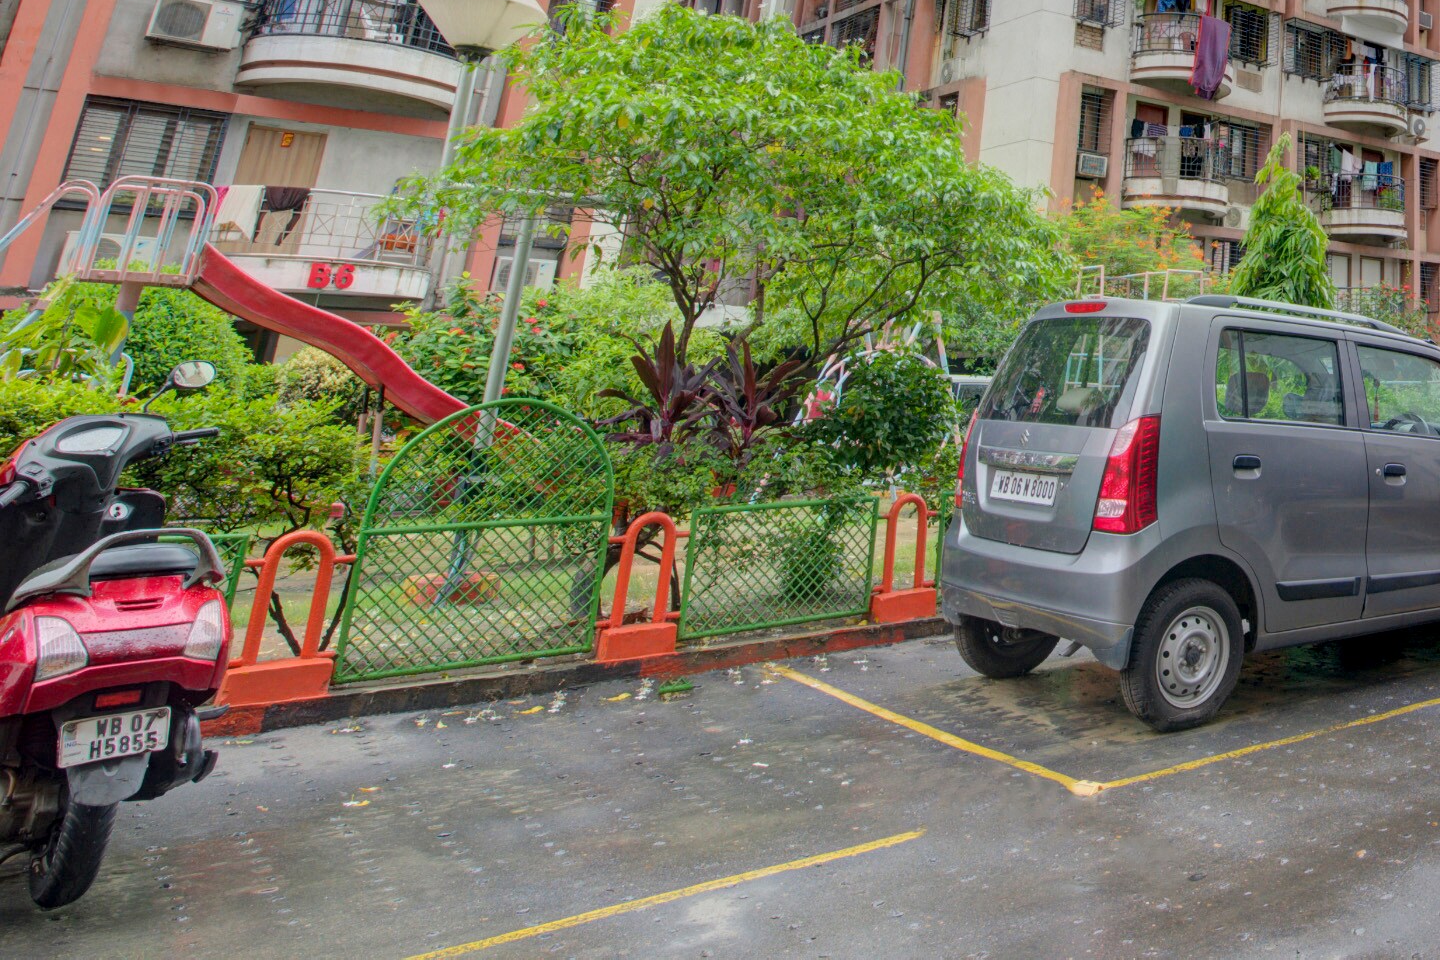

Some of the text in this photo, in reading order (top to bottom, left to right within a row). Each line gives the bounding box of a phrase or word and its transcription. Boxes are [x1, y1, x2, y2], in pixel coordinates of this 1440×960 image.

[998, 476, 1011, 493] WB
[1011, 477, 1023, 495] 06
[1030, 480, 1055, 499] 8000
[97, 712, 157, 737] WB 07
[89, 731, 158, 760] H5855
